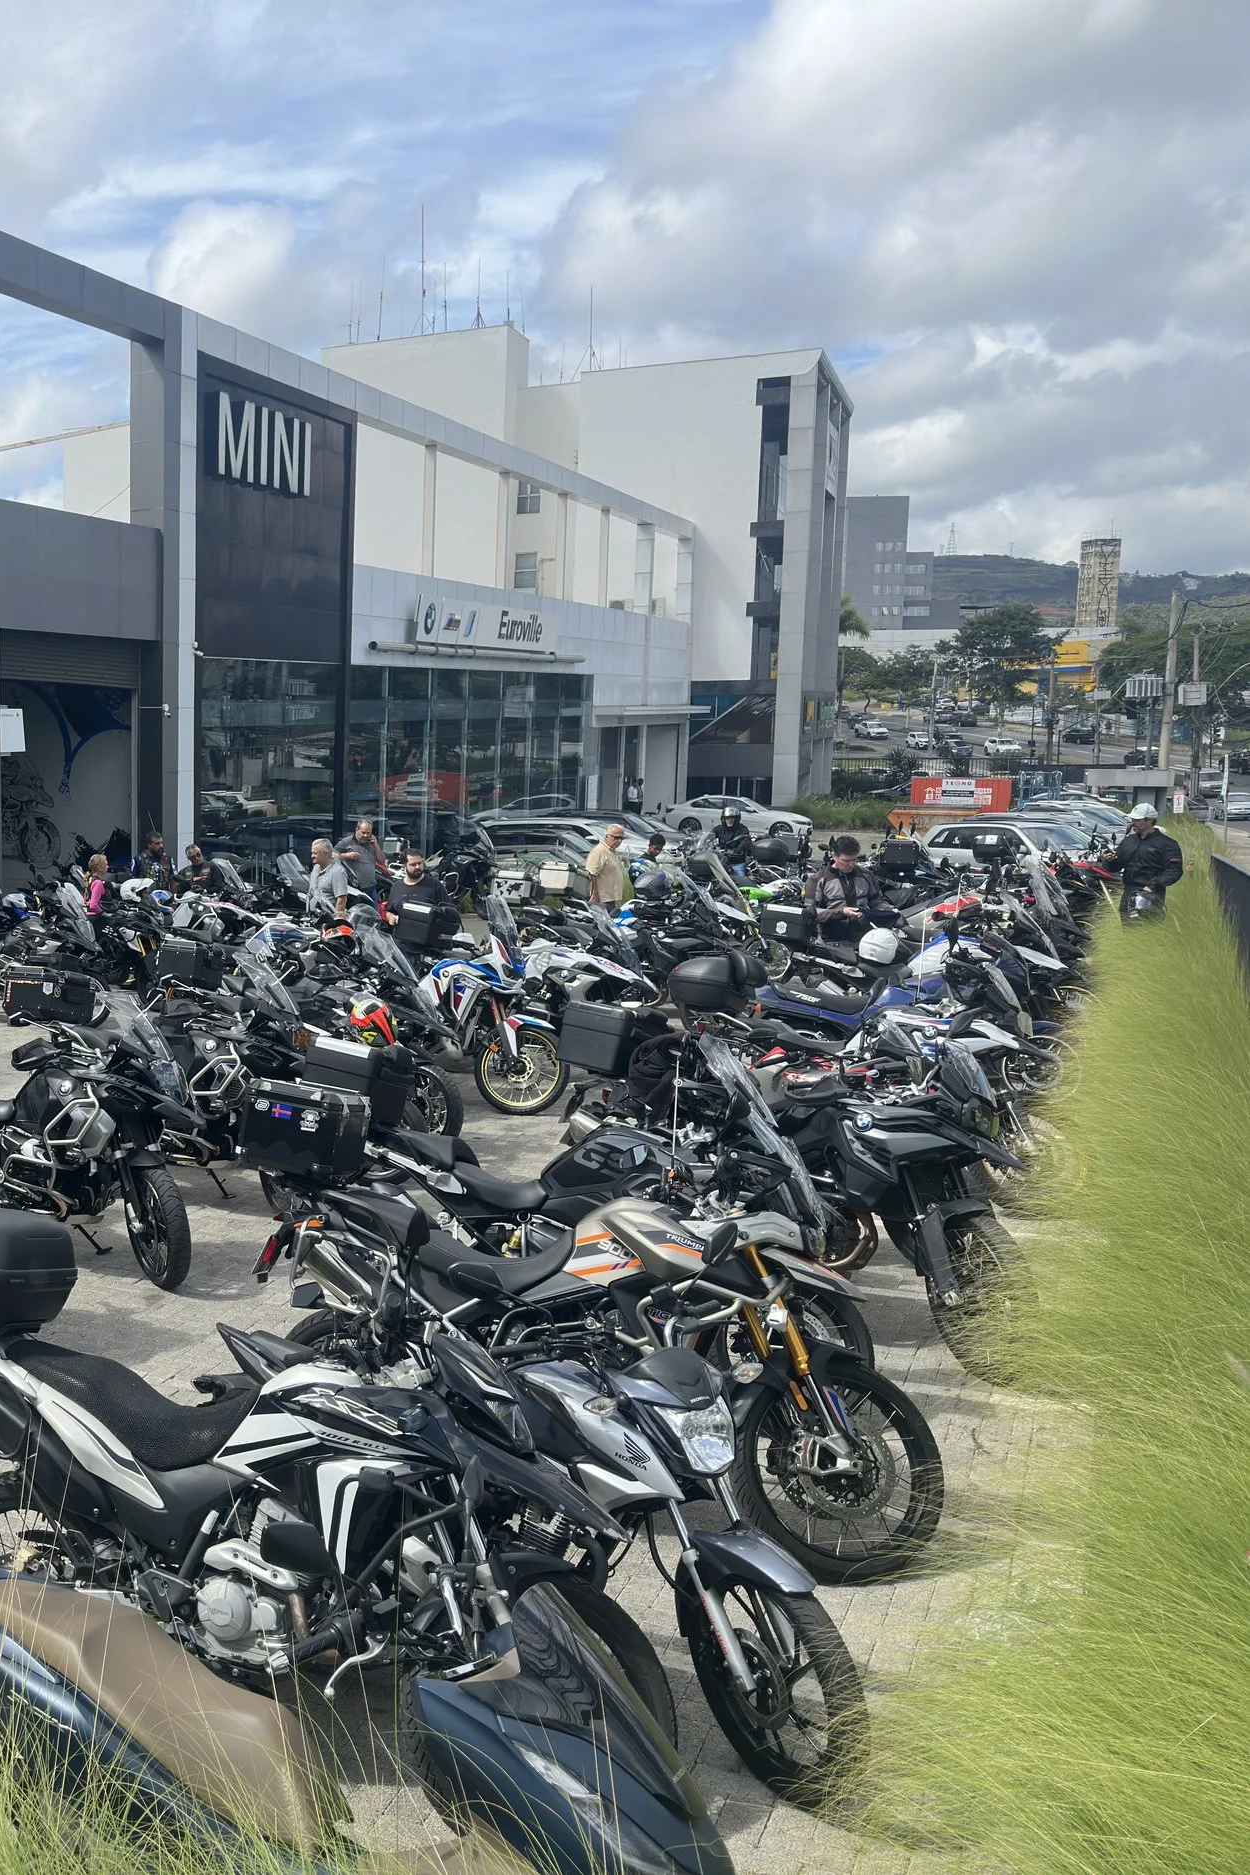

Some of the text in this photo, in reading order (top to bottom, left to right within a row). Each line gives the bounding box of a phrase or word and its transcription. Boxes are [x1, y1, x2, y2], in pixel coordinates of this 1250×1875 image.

[218, 391, 311, 497] MINI
[498, 610, 543, 643] Euroville
[597, 1239, 631, 1260] 900
[690, 1396, 710, 1404] HONDA
[351, 1439, 389, 1451] RALLY
[614, 1452, 647, 1471] HONDA
